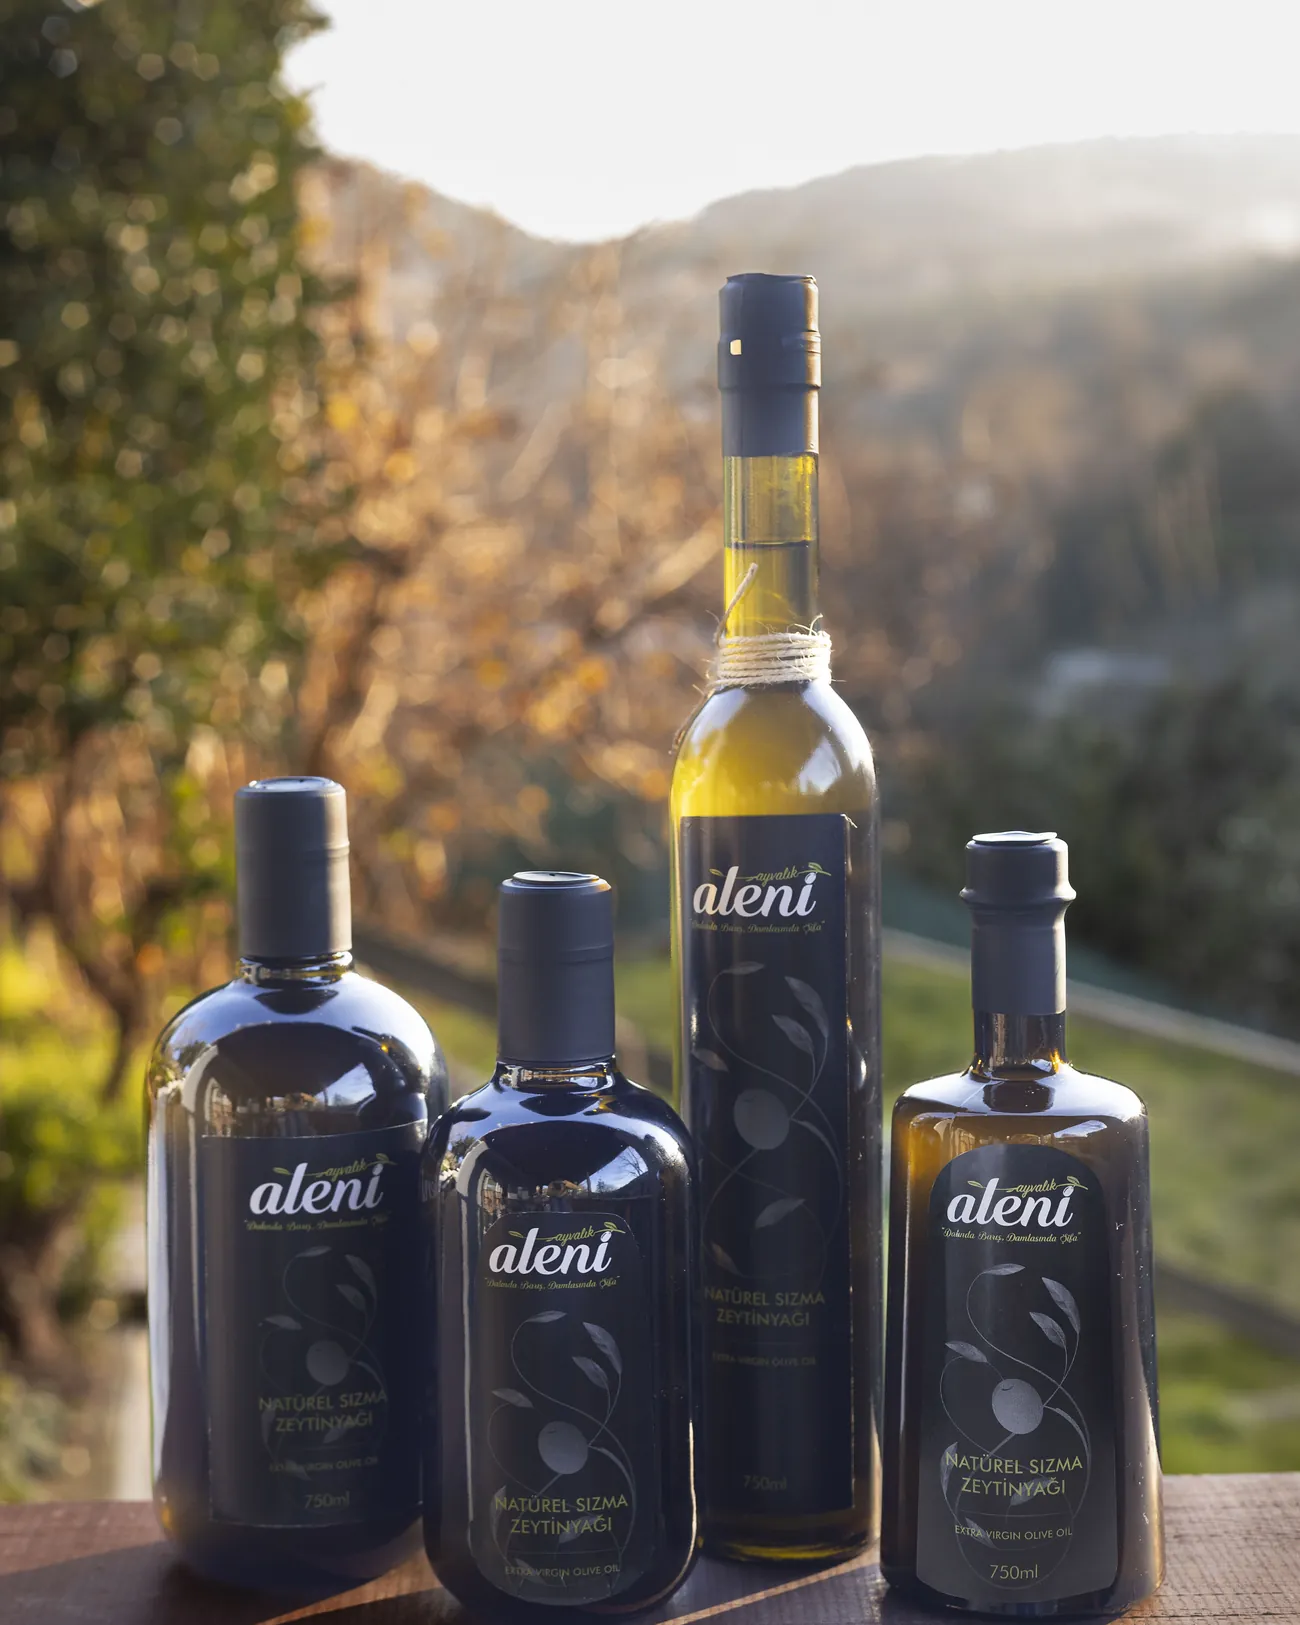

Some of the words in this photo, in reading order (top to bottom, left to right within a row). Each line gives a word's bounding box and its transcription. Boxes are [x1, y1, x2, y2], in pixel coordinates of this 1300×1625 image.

[693, 866, 817, 917] aleni
[249, 1162, 384, 1215] aleni
[1016, 1178, 1057, 1198] ayvalık
[947, 1177, 1074, 1228] aleni
[554, 1225, 595, 1246] ayvalık
[489, 1227, 612, 1275] aleni
[775, 1291, 825, 1306] SIZMA
[340, 1390, 388, 1408] SIZMA
[276, 1410, 373, 1433] ZEYTİNYAĞI
[945, 1452, 1023, 1475] NATÜREL
[1030, 1455, 1083, 1475] SIZMA
[961, 1477, 1066, 1497] ZEYTİNYAĞI
[304, 1490, 350, 1509] 750ml
[495, 1495, 570, 1513] NATÜREL
[576, 1494, 629, 1512] SIZMA
[511, 1514, 612, 1535] ZEYTİNYAĞI
[955, 1525, 983, 1538] EXTRA
[986, 1530, 1020, 1541] VIRGIN
[1024, 1530, 1053, 1541] OLIVE
[1056, 1528, 1073, 1538] OIL
[535, 1567, 570, 1578] VIRGIN
[573, 1565, 601, 1576] OLIVE
[604, 1565, 621, 1573] OIL
[989, 1563, 1039, 1580] 750ml
